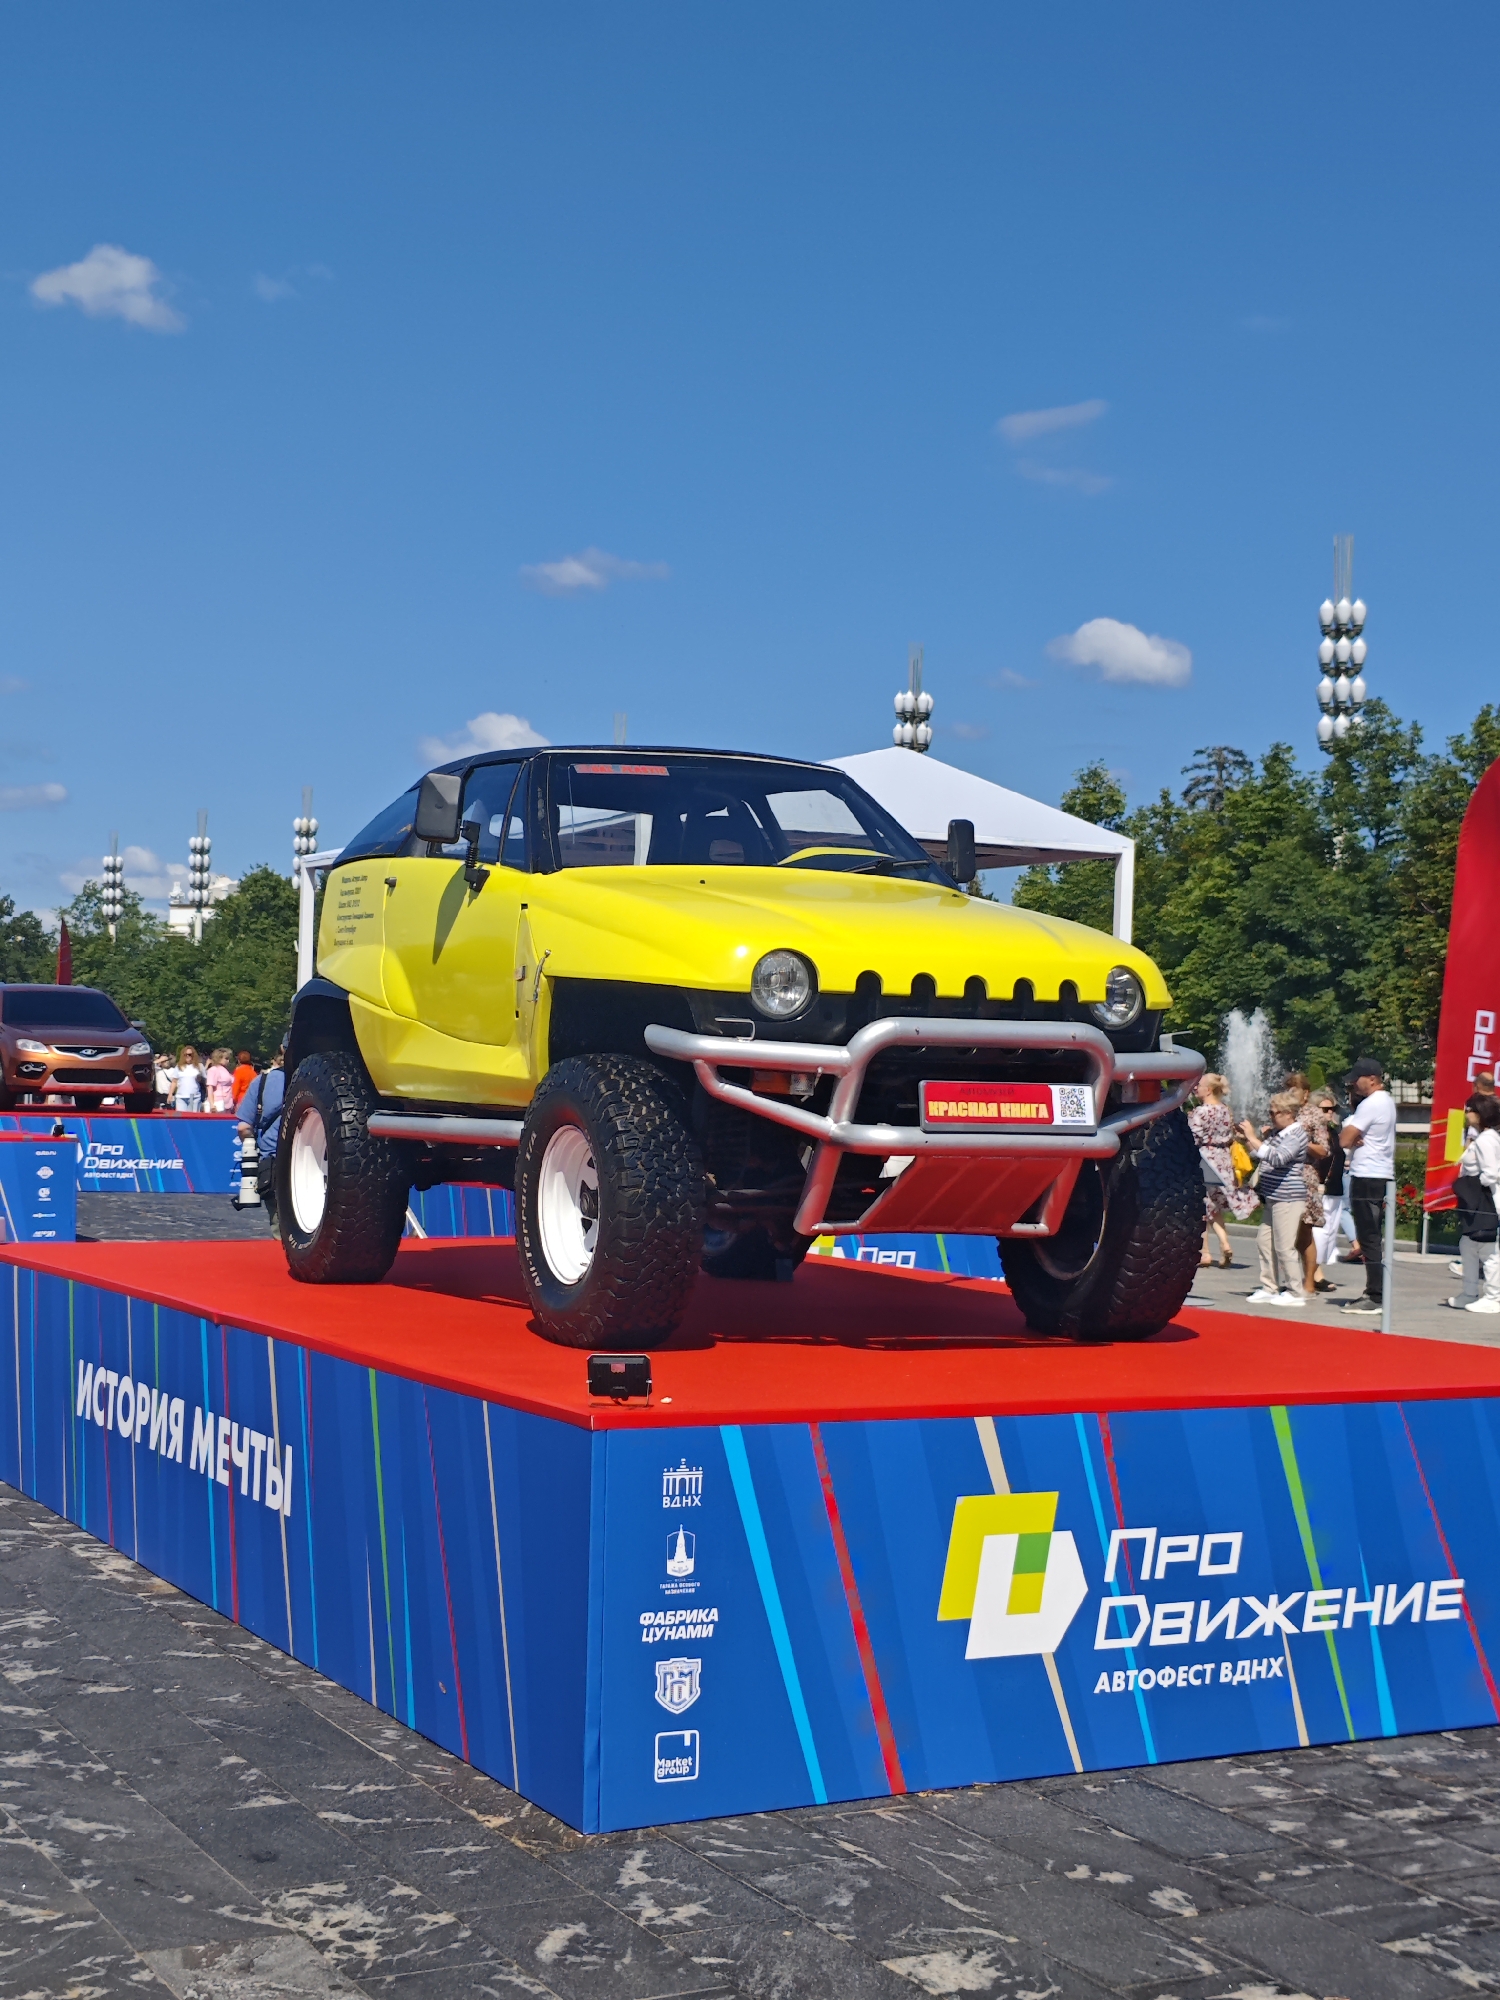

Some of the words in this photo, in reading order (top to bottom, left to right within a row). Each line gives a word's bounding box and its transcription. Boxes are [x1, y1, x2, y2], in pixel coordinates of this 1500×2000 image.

[928, 1101, 998, 1118] КРАСНАЯ
[1000, 1102, 1050, 1119] КНИГА
[76, 1358, 185, 1464] ИСТОРИЯ
[189, 1405, 293, 1518] МЕЧТЫ
[662, 1494, 702, 1508] ВДНХ
[639, 1607, 719, 1626] ФАБРИКА
[641, 1624, 715, 1643] ЦУНАМИ
[1093, 1662, 1216, 1694] АВТОФЕСТ
[1218, 1655, 1286, 1686] ВДНХ
[657, 1755, 692, 1768] Market
[657, 1765, 690, 1778] group
